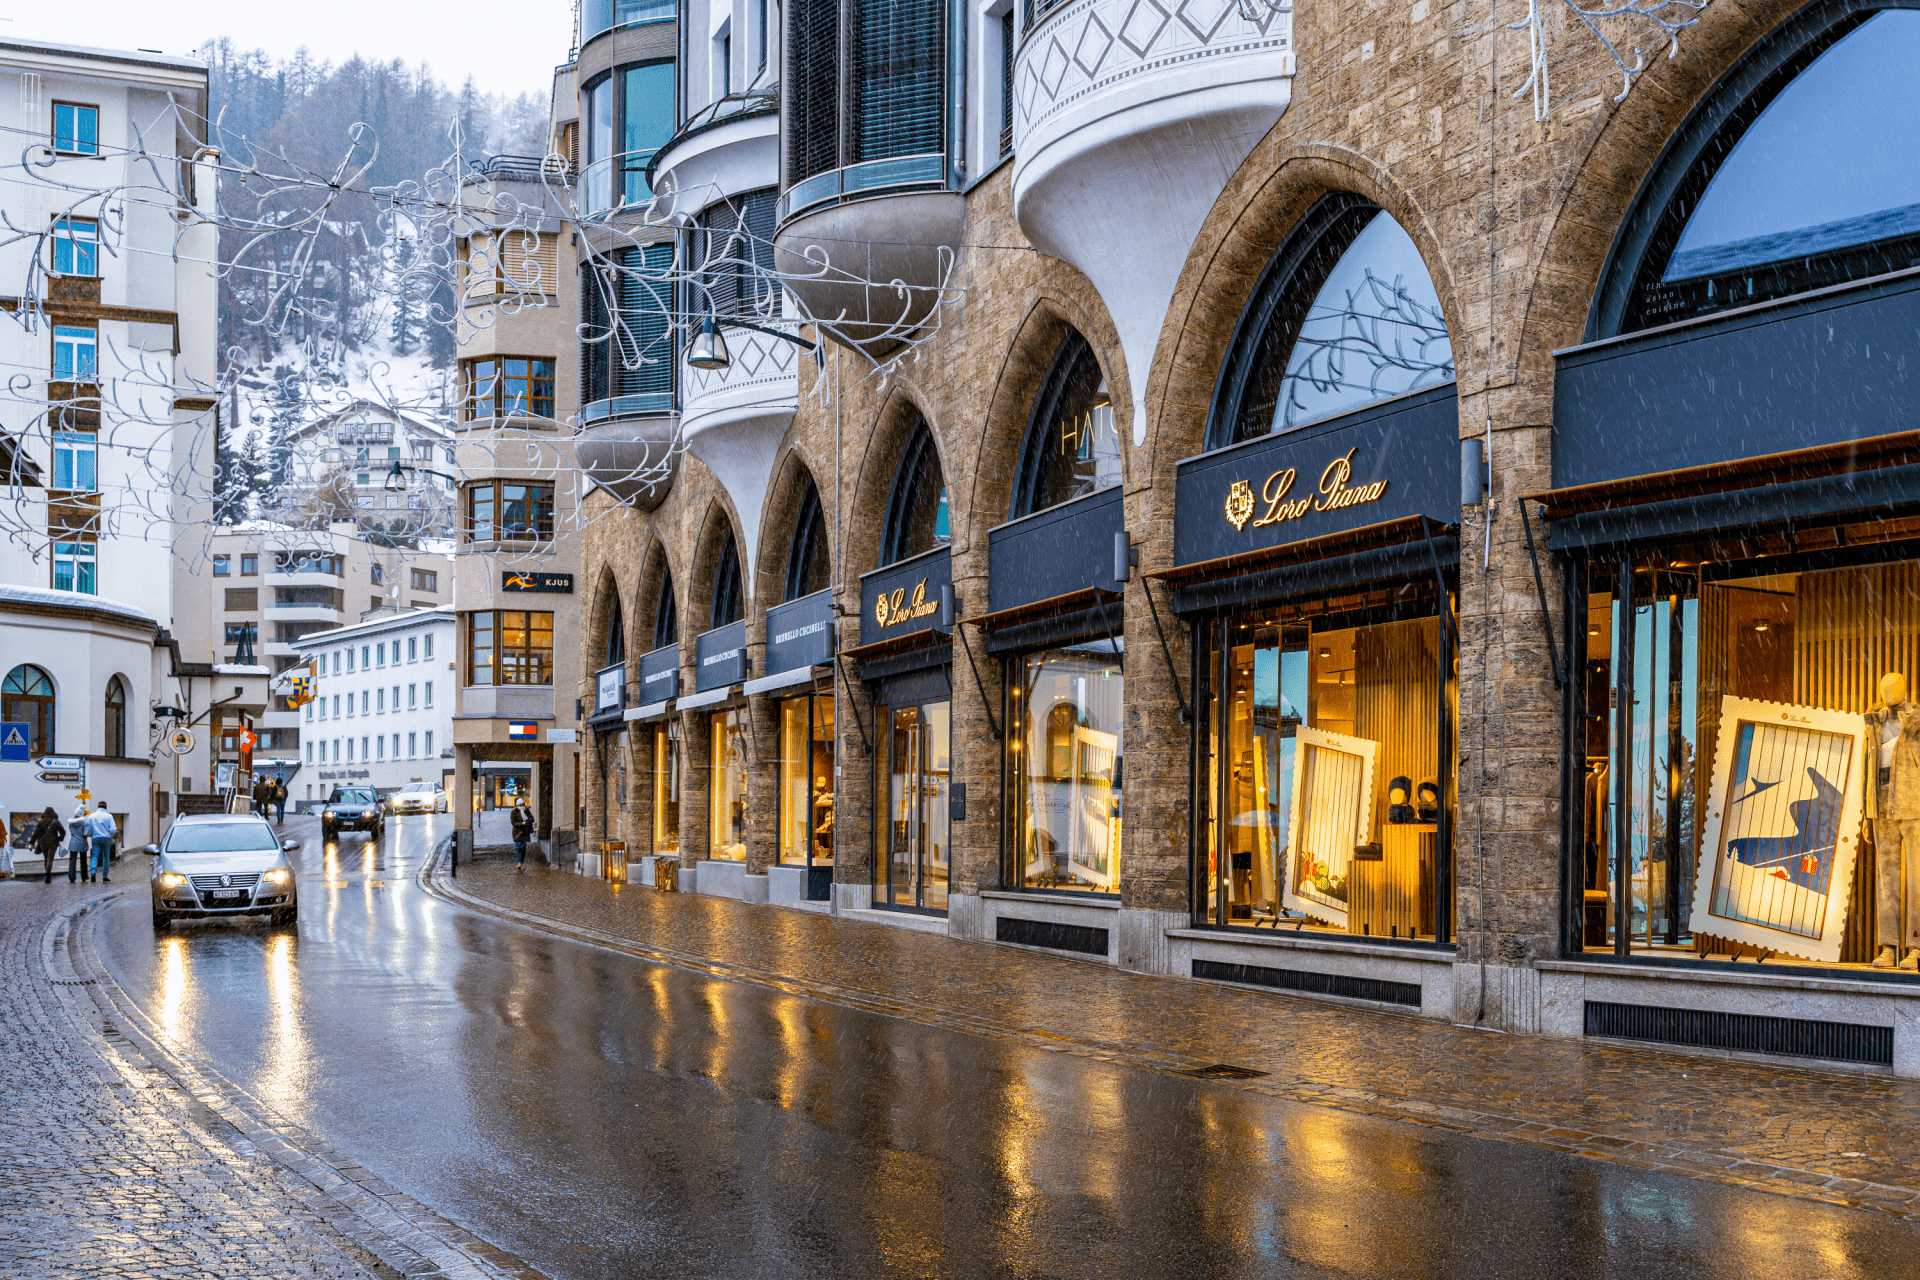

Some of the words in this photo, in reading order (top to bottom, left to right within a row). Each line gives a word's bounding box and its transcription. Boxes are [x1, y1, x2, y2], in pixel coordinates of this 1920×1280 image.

[1253, 467, 1314, 527] Loro
[1315, 447, 1388, 512] Piana
[545, 578, 569, 587] KJUS
[887, 588, 911, 625] Loro
[910, 576, 938, 618] Piana
